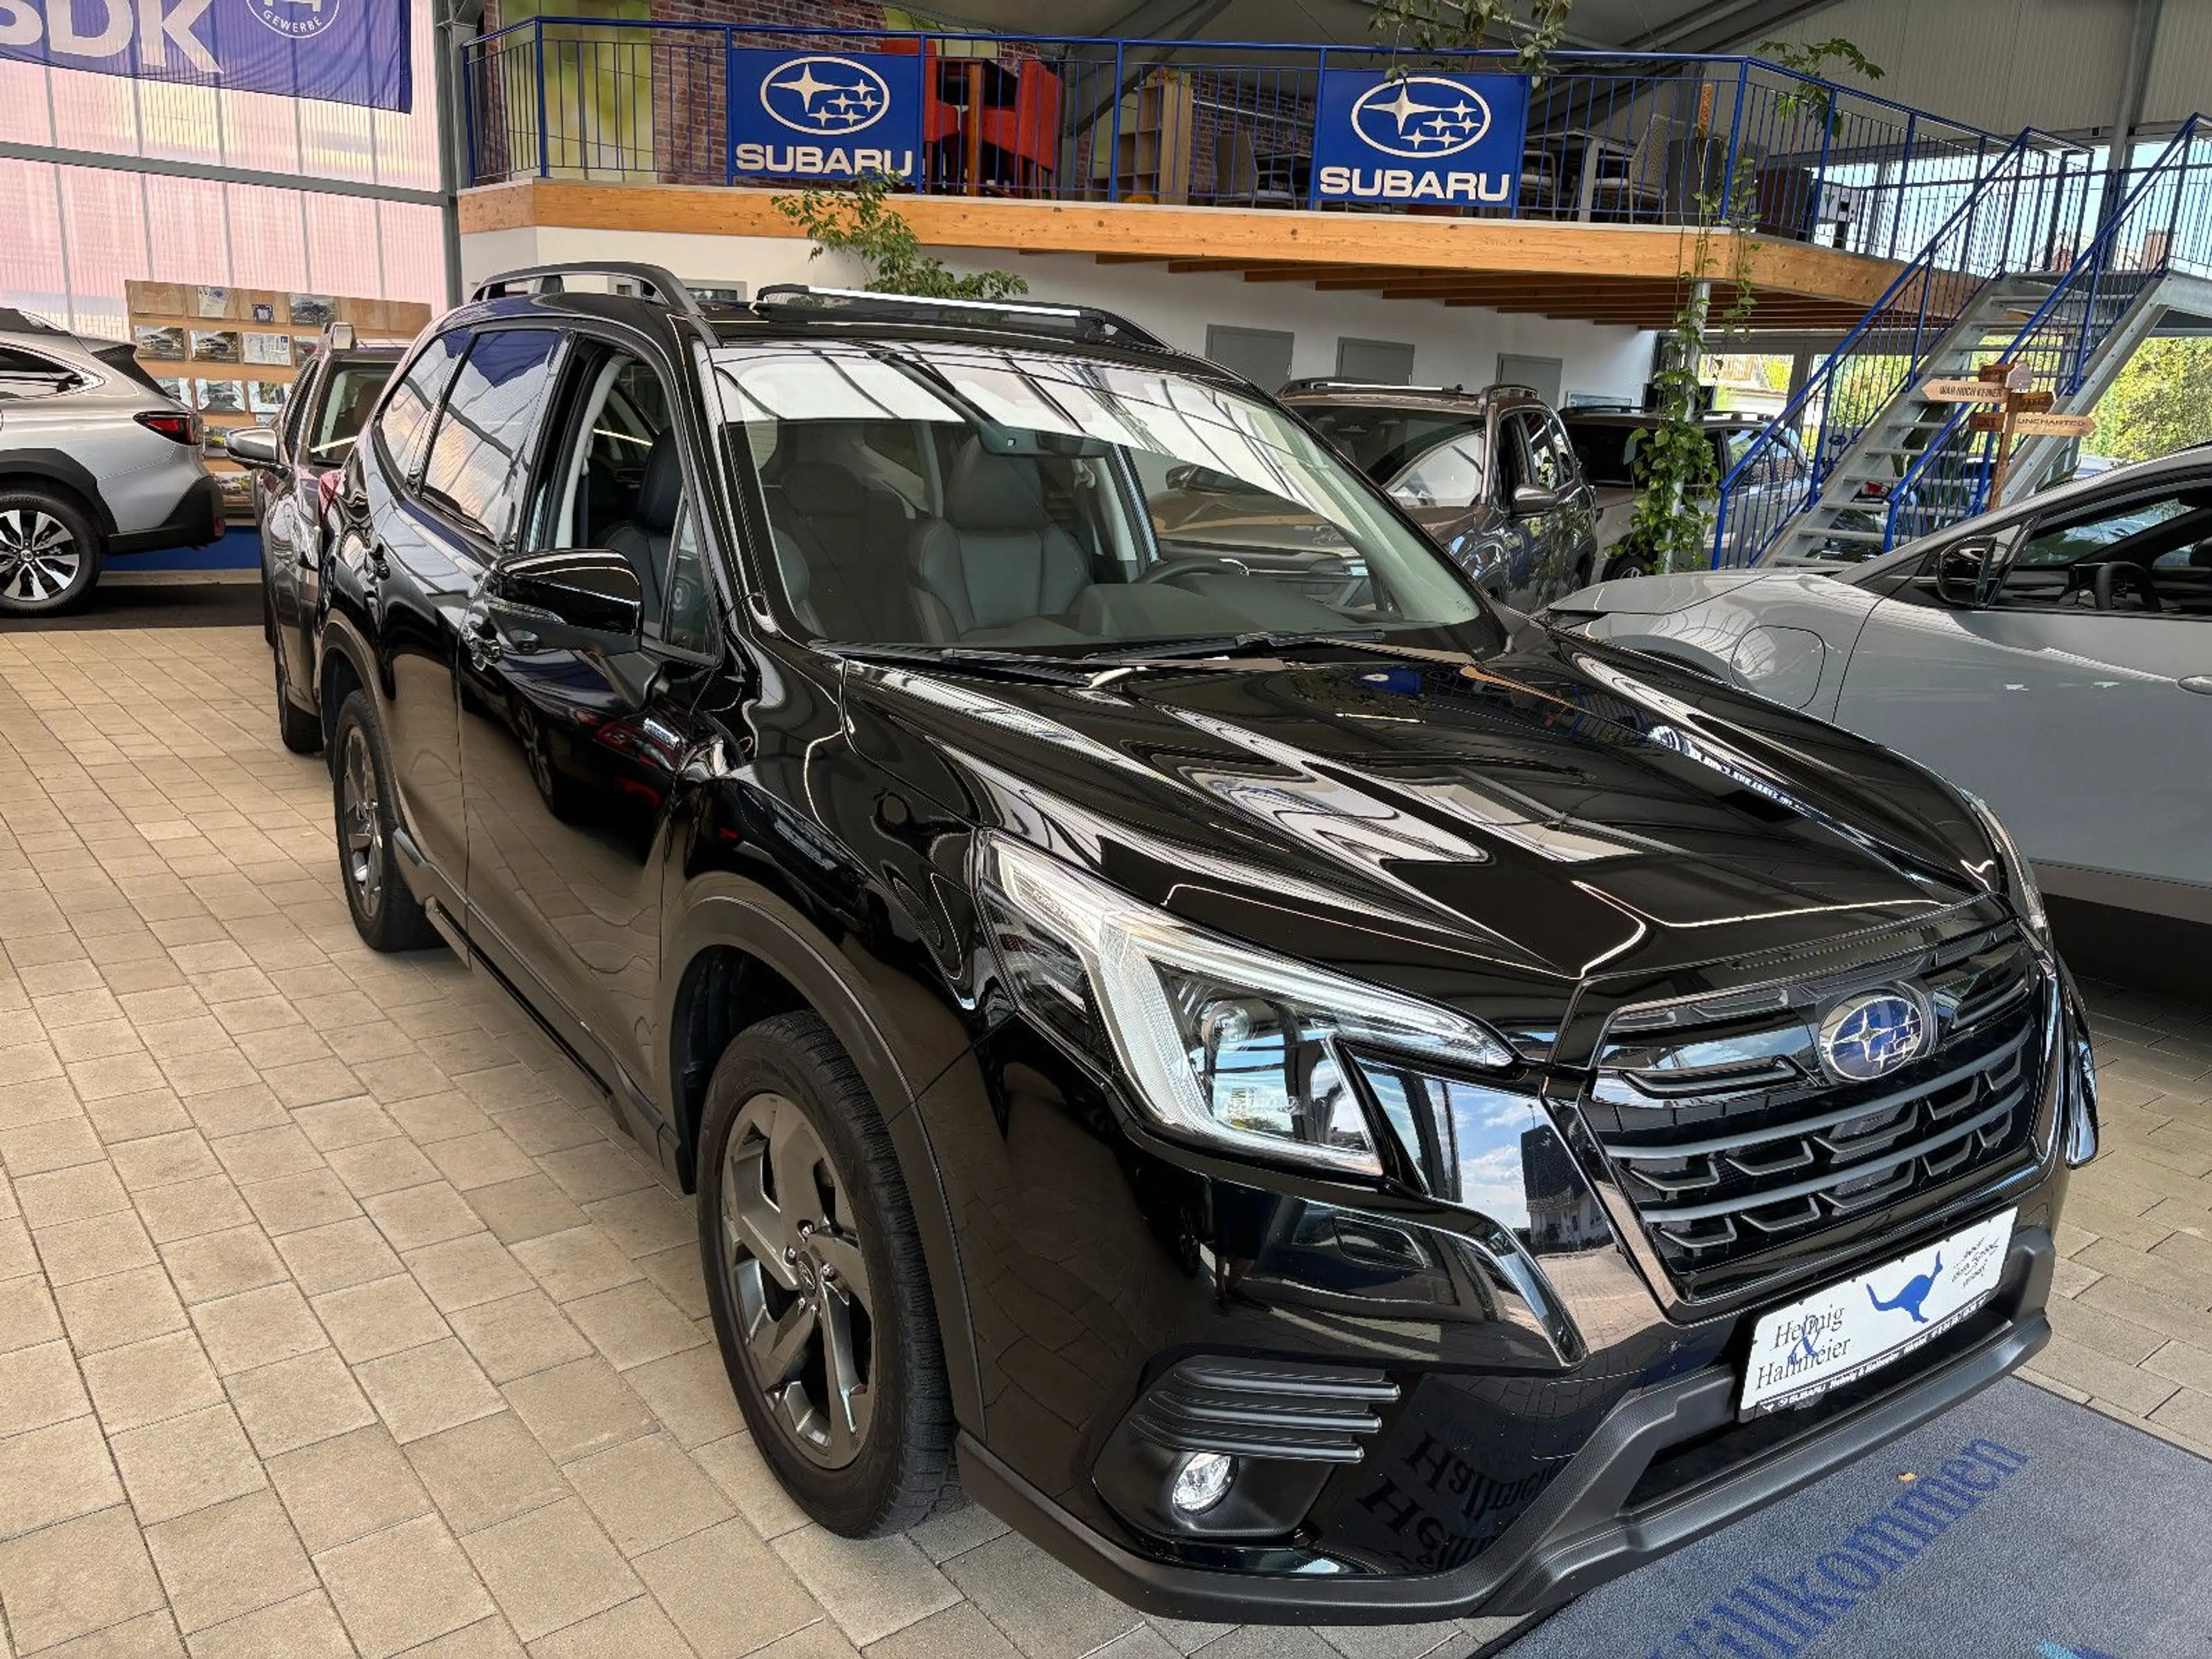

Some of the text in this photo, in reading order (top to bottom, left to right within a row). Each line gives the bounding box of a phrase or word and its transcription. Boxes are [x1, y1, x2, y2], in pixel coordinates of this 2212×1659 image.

[263, 10, 323, 33] GEWERBE
[736, 143, 912, 177] SUBARU
[1320, 166, 1510, 202] SUBARU
[1755, 1338, 1851, 1391] Hallmeier
[1646, 1437, 2030, 1659] illkommen
